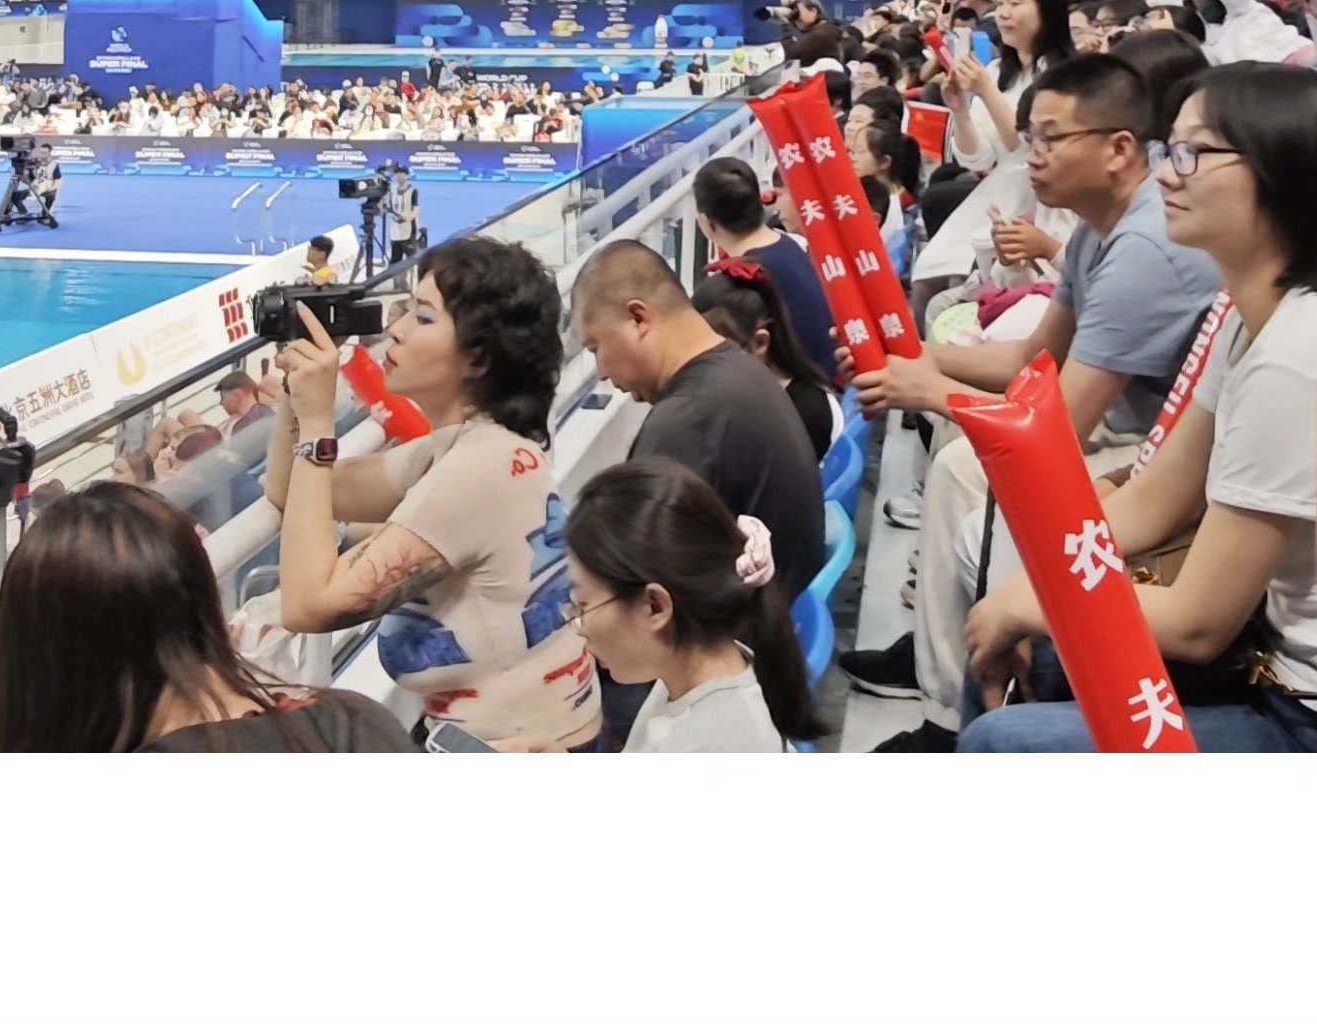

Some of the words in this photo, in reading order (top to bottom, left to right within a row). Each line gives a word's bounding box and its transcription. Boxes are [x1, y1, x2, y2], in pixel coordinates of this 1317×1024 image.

[779, 142, 869, 346] 农夫山泉
[810, 136, 905, 339] 农夫山泉
[1064, 519, 1184, 750] 农夫
